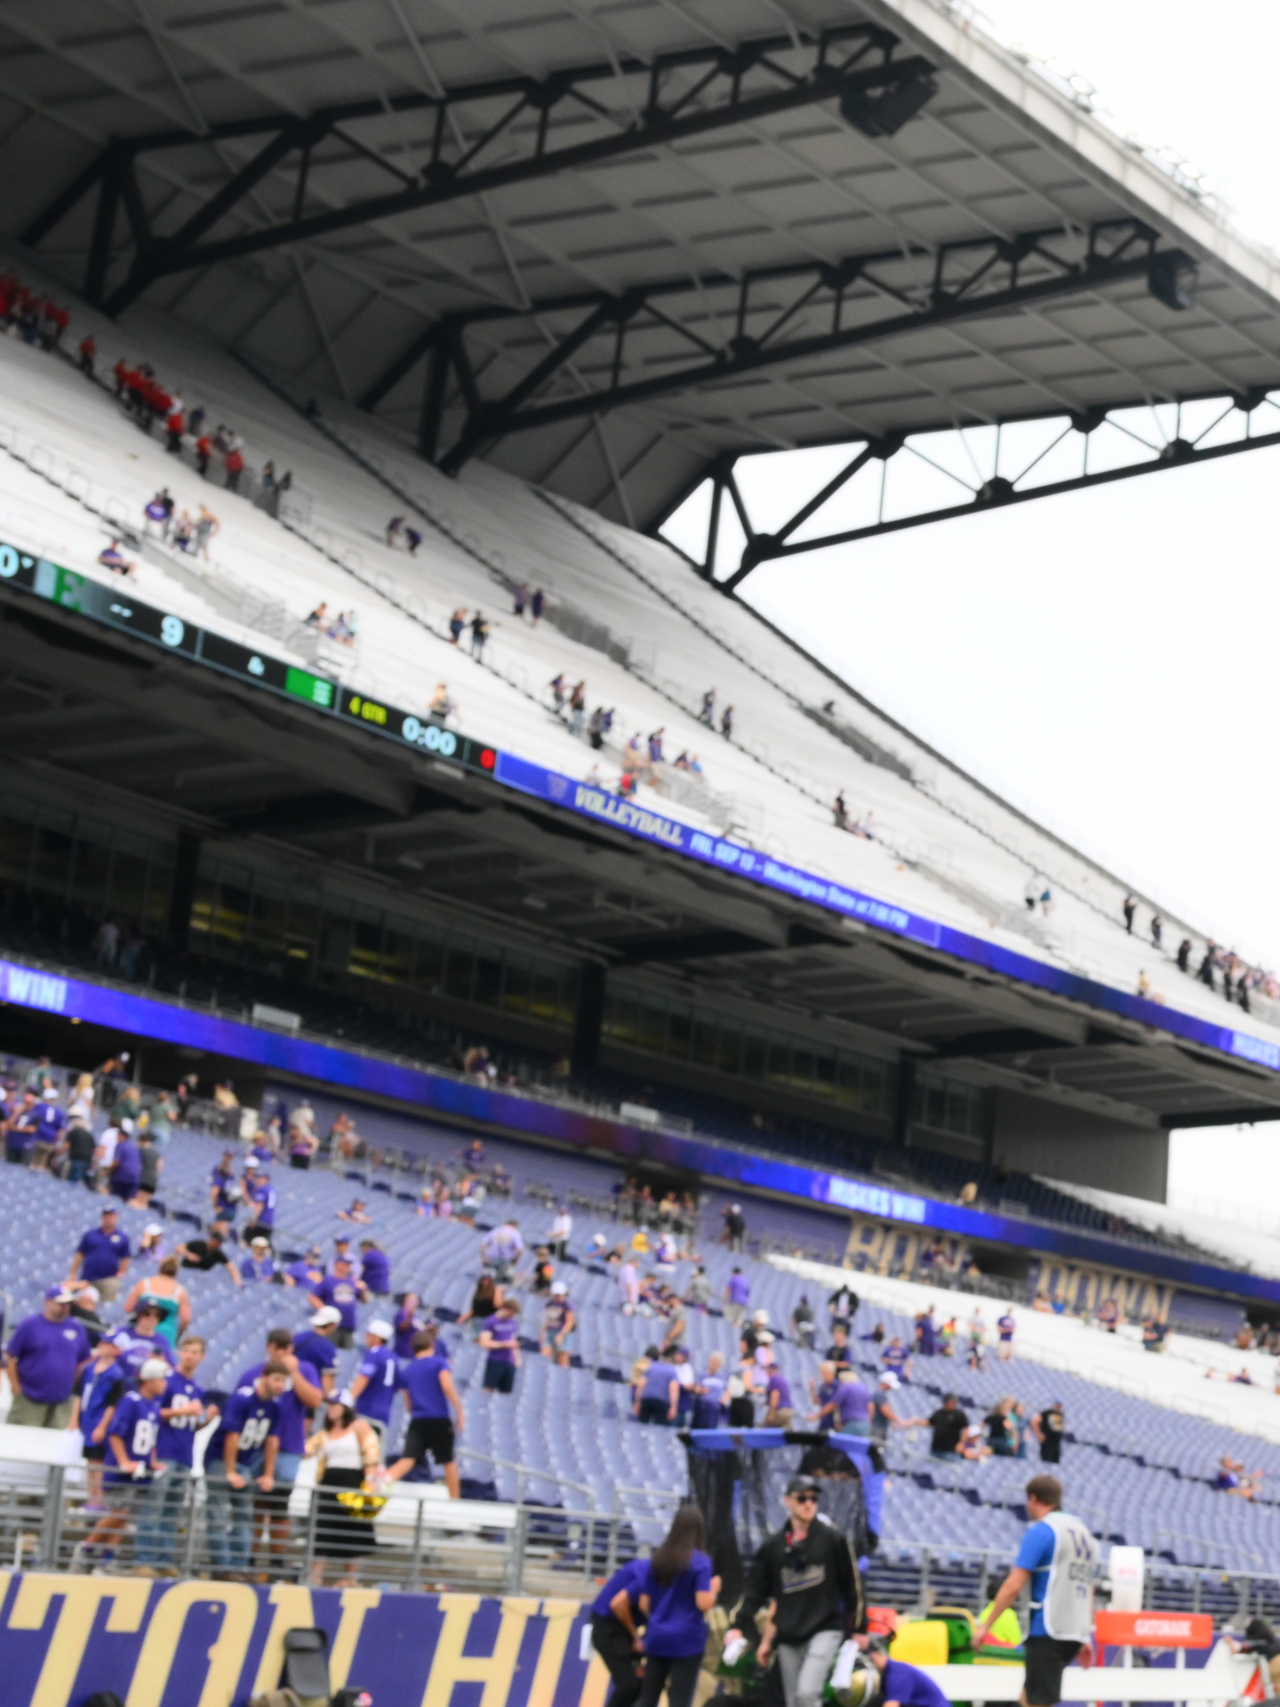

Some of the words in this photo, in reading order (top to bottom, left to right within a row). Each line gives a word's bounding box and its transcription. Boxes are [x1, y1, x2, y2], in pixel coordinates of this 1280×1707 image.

[161, 615, 184, 647] 9
[402, 717, 457, 757] 0:00
[575, 785, 684, 846] VOLLEYBALL
[132, 1419, 159, 1455] 8
[0, 1570, 381, 1707] TON
